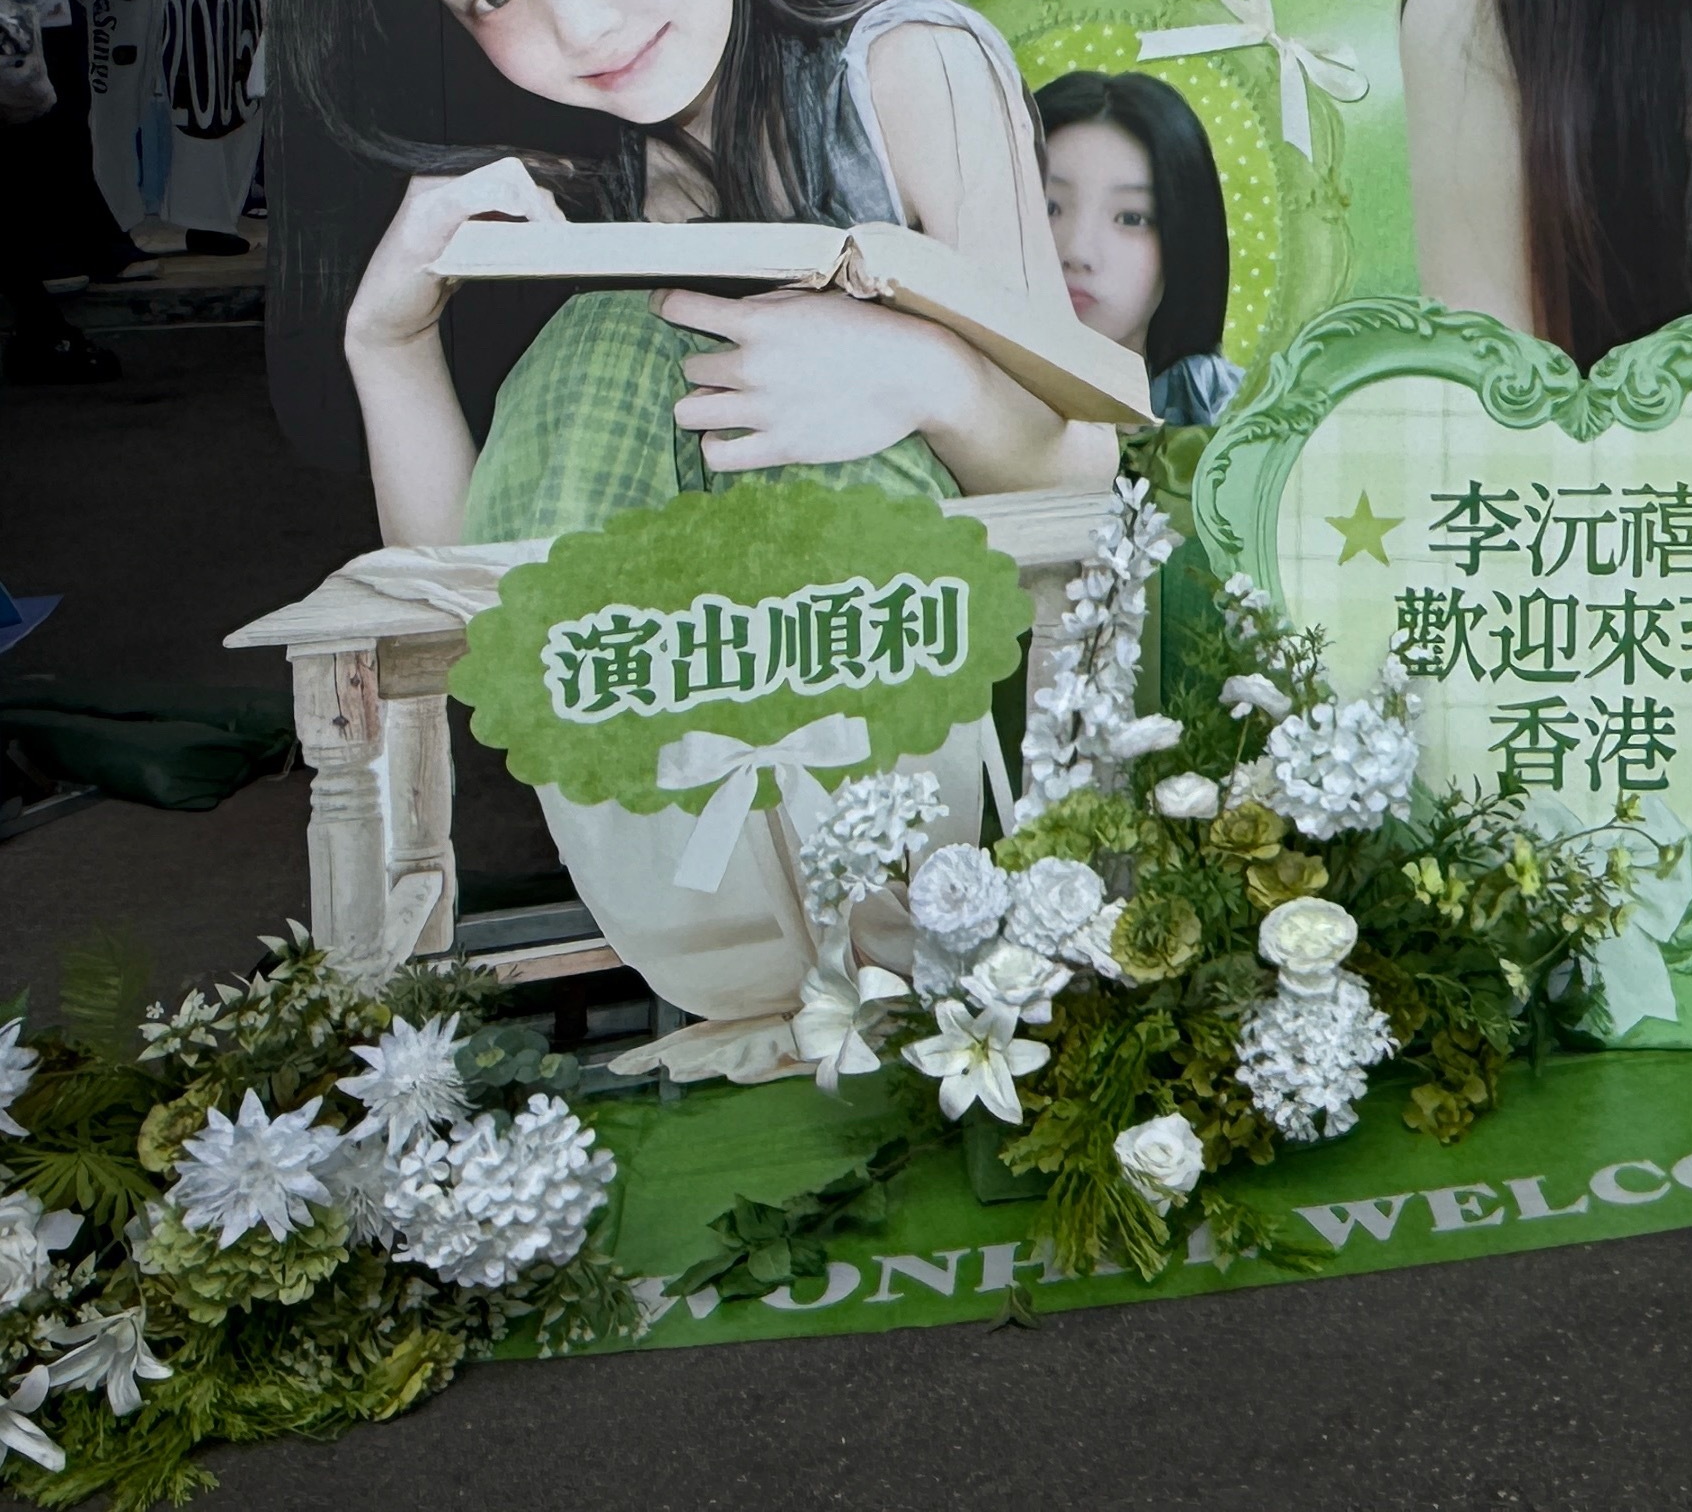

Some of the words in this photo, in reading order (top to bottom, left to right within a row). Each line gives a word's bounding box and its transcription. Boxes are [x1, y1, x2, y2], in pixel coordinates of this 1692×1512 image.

[554, 580, 961, 713] 演出順利
[1488, 695, 1677, 795] 香港
